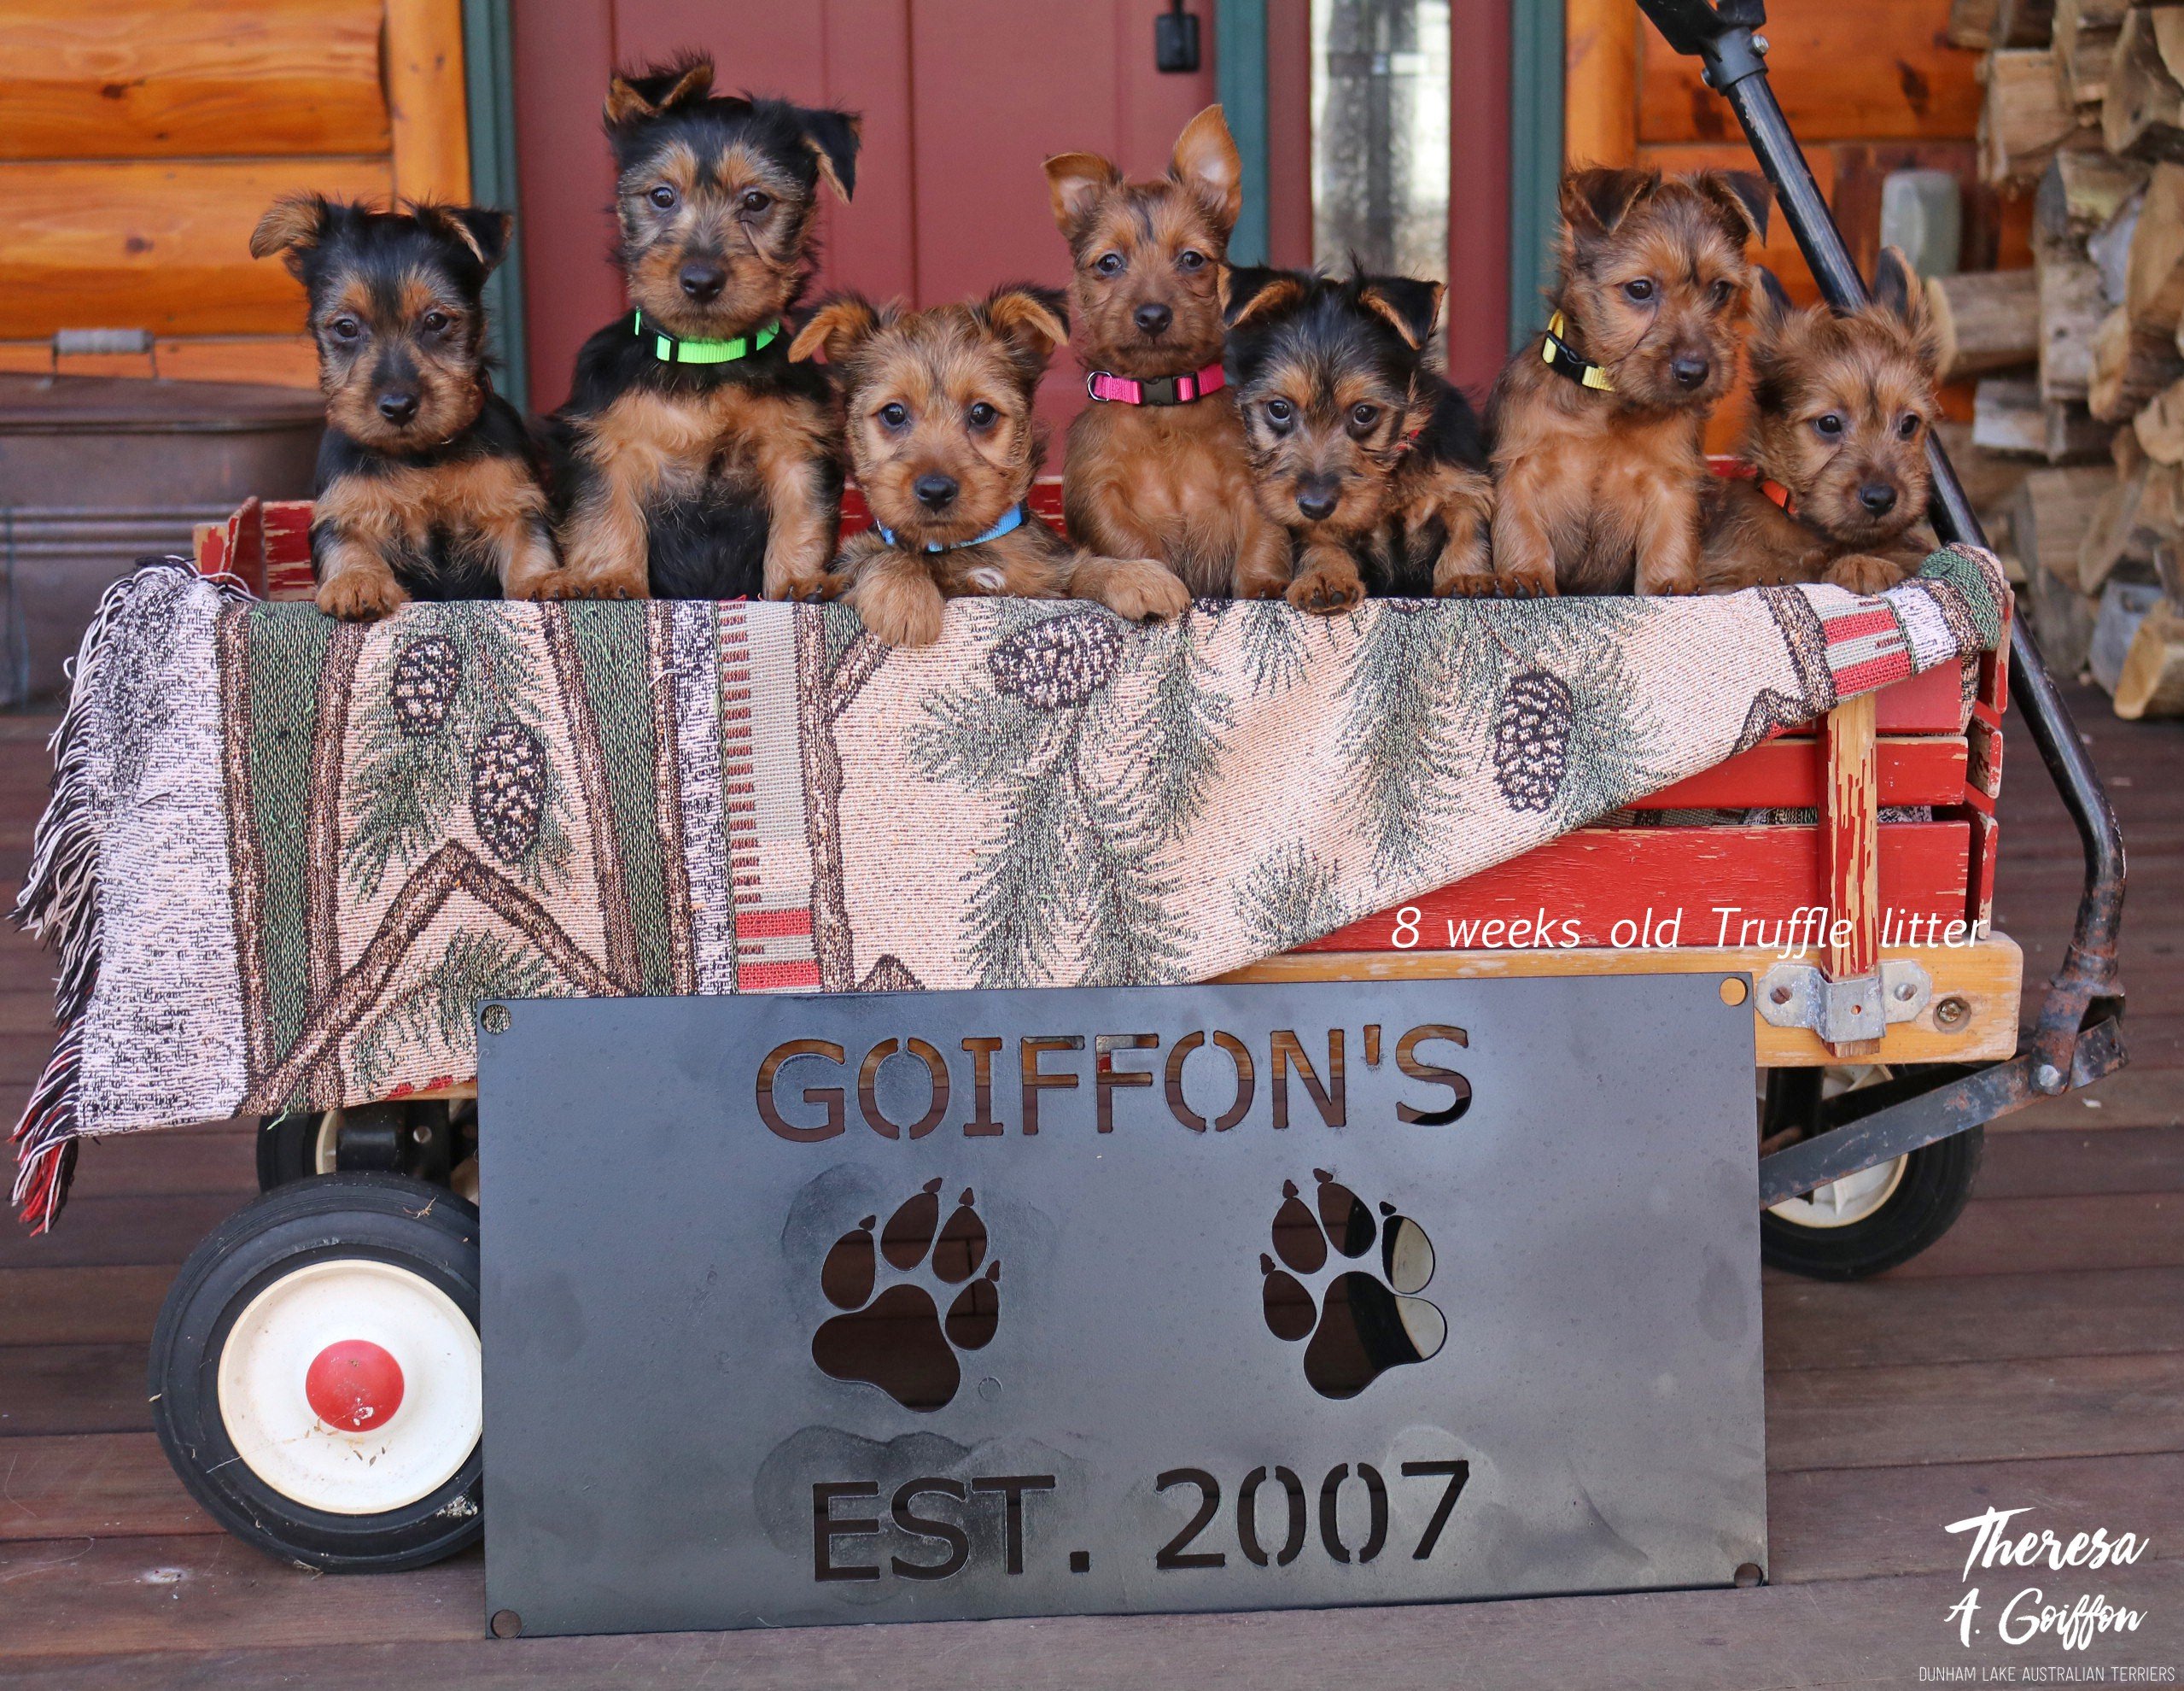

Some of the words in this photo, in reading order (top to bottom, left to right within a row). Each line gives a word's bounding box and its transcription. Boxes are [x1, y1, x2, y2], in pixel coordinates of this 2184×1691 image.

[756, 1025, 1473, 1143] GOIFFON'S
[813, 1475, 1090, 1582] EST.
[1156, 1460, 1469, 1570] 2007
